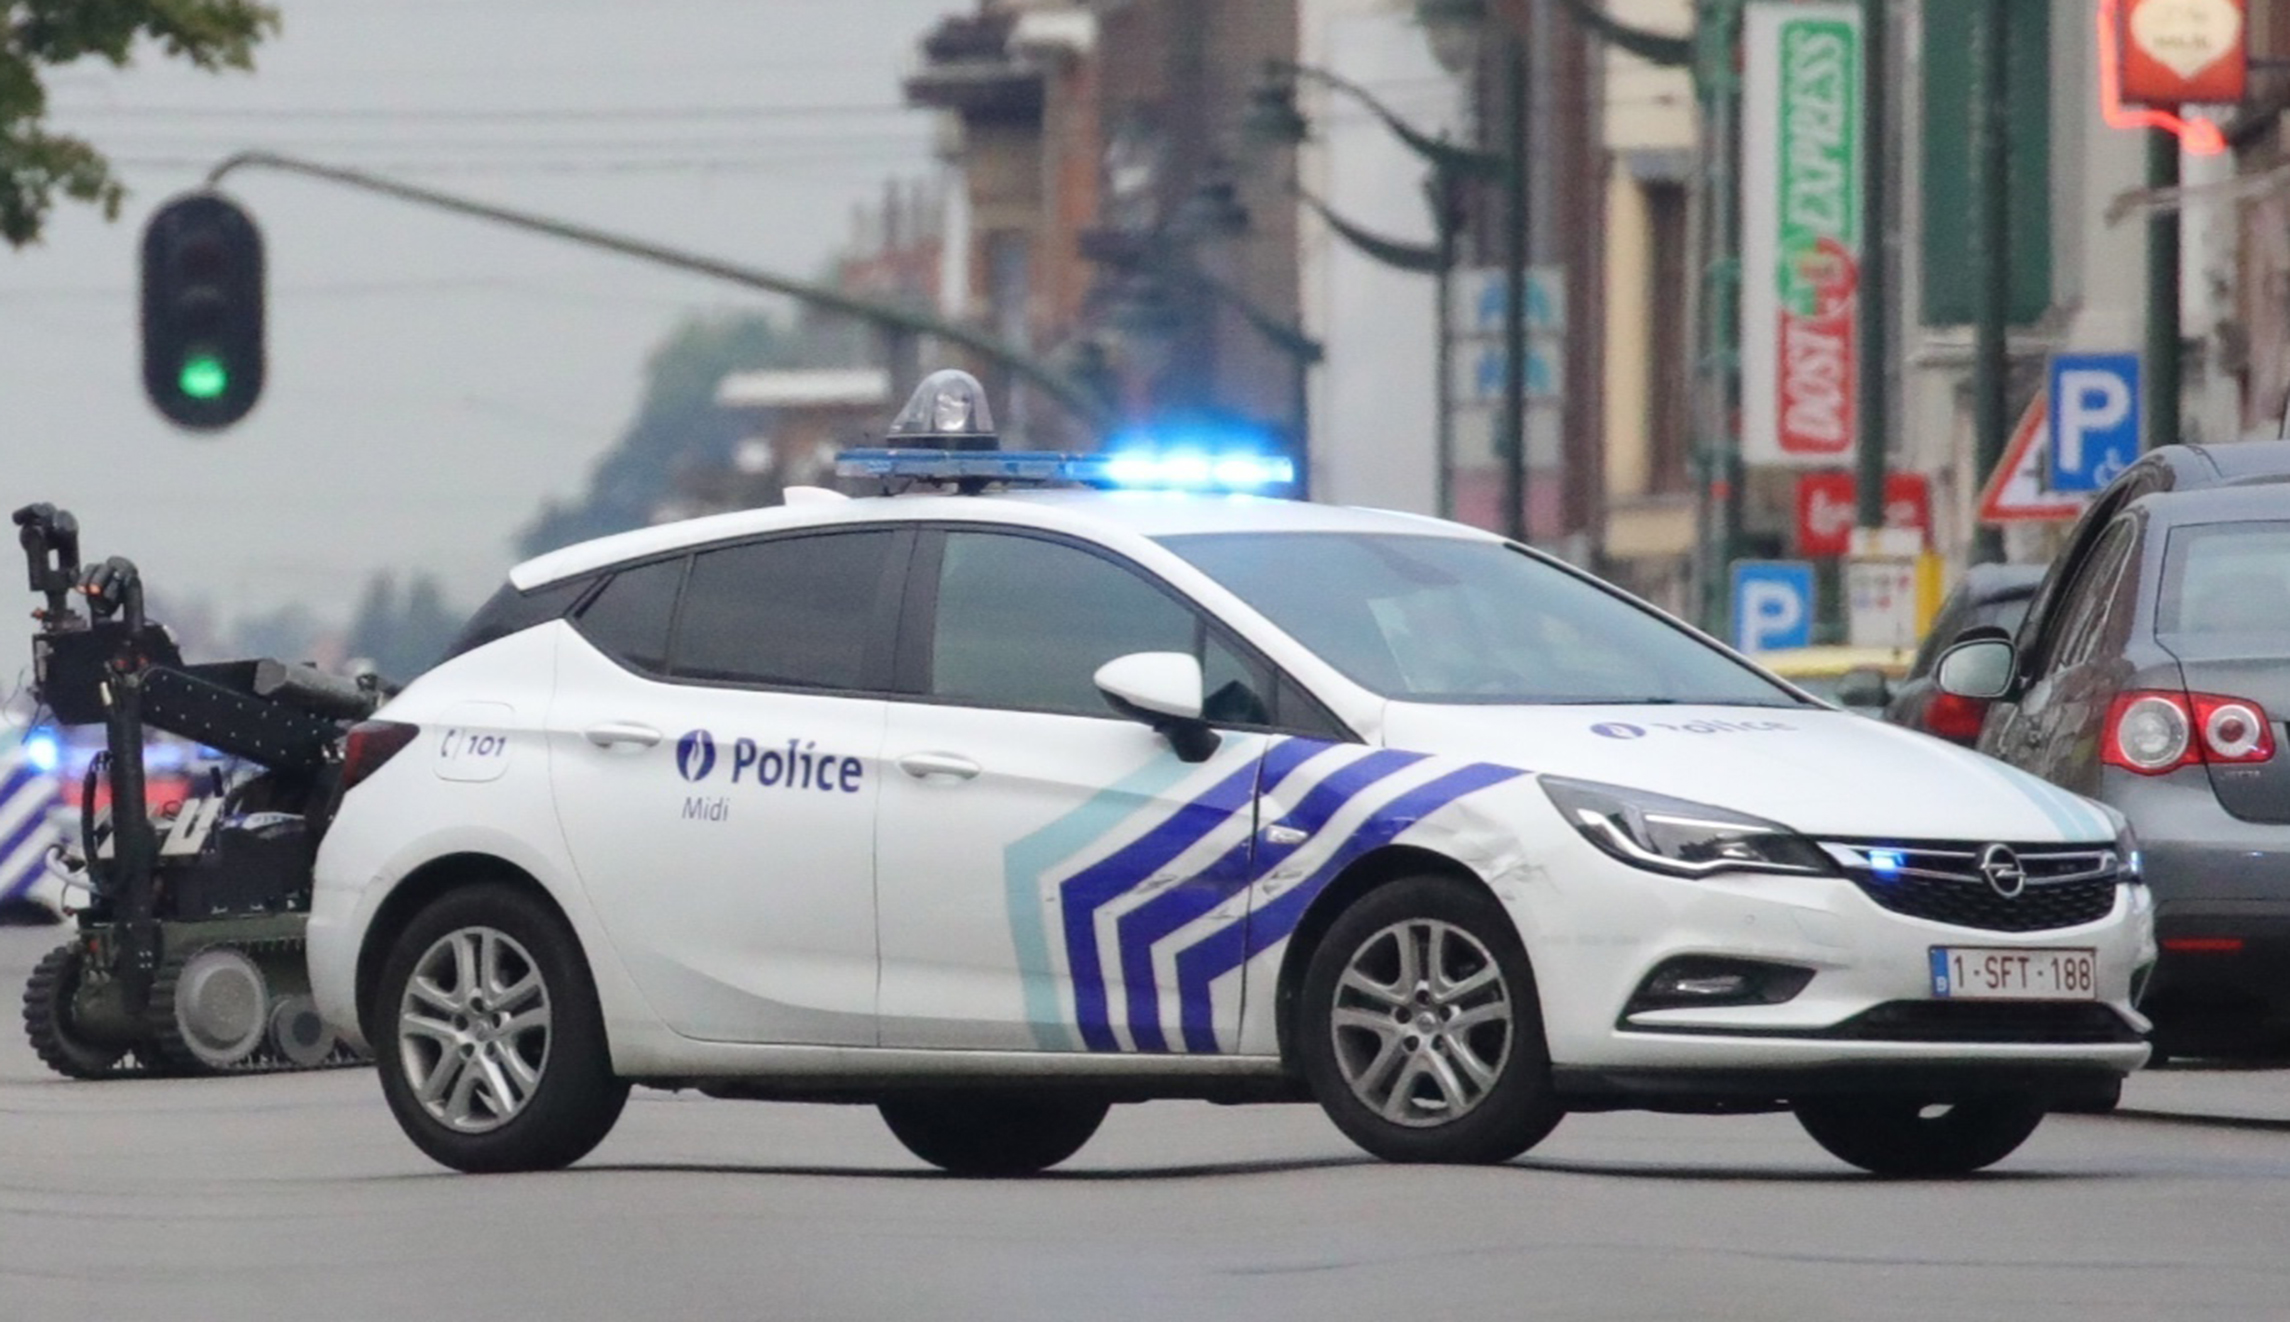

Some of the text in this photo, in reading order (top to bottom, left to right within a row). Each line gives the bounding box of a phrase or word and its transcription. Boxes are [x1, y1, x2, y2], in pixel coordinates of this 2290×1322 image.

[1790, 28, 1844, 232] EXPRESS
[2057, 369, 2131, 473] P
[1740, 579, 1800, 651] P
[467, 735, 506, 757] 101
[731, 737, 864, 793] Police
[682, 797, 731, 822] Midi
[1953, 954, 2092, 991] 1-SFT-188
